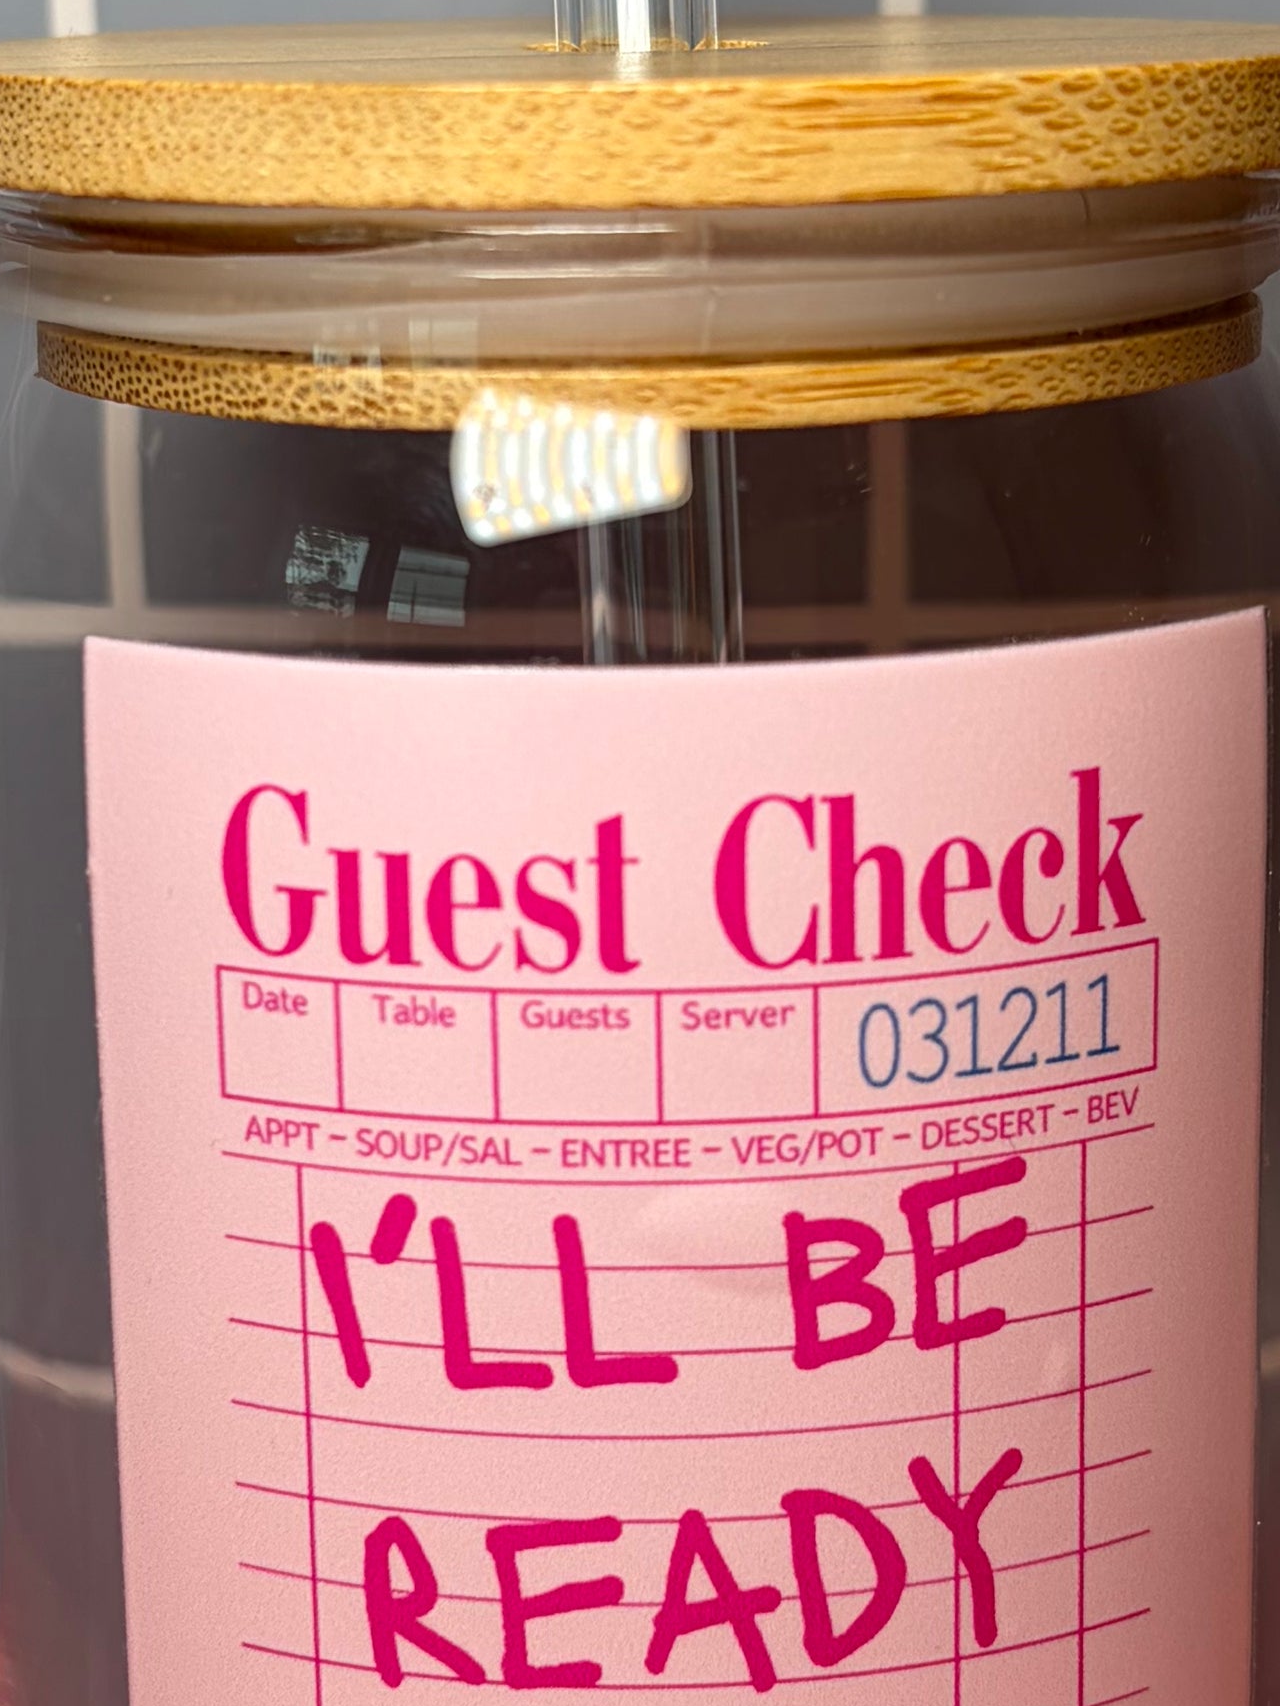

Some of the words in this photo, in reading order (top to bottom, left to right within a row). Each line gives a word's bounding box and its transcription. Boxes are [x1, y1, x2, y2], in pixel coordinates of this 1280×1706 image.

[221, 783, 640, 974] Guest
[713, 766, 1147, 971] Check
[242, 980, 309, 1017] Date
[372, 994, 457, 1028] Table
[520, 1000, 631, 1031] Guests
[681, 1001, 795, 1030] Server
[857, 973, 1120, 1089] 031211
[244, 1115, 320, 1151] APPT
[355, 1128, 523, 1168] SOUP/SAL
[561, 1138, 691, 1168] ENTREE
[730, 1126, 883, 1166] VEG/POT
[921, 1104, 1056, 1150] DESSERT
[1086, 1086, 1140, 1125] BEV
[311, 1194, 677, 1389] I'LL
[783, 1156, 1028, 1370] BE
[363, 1448, 1023, 1691] READY
